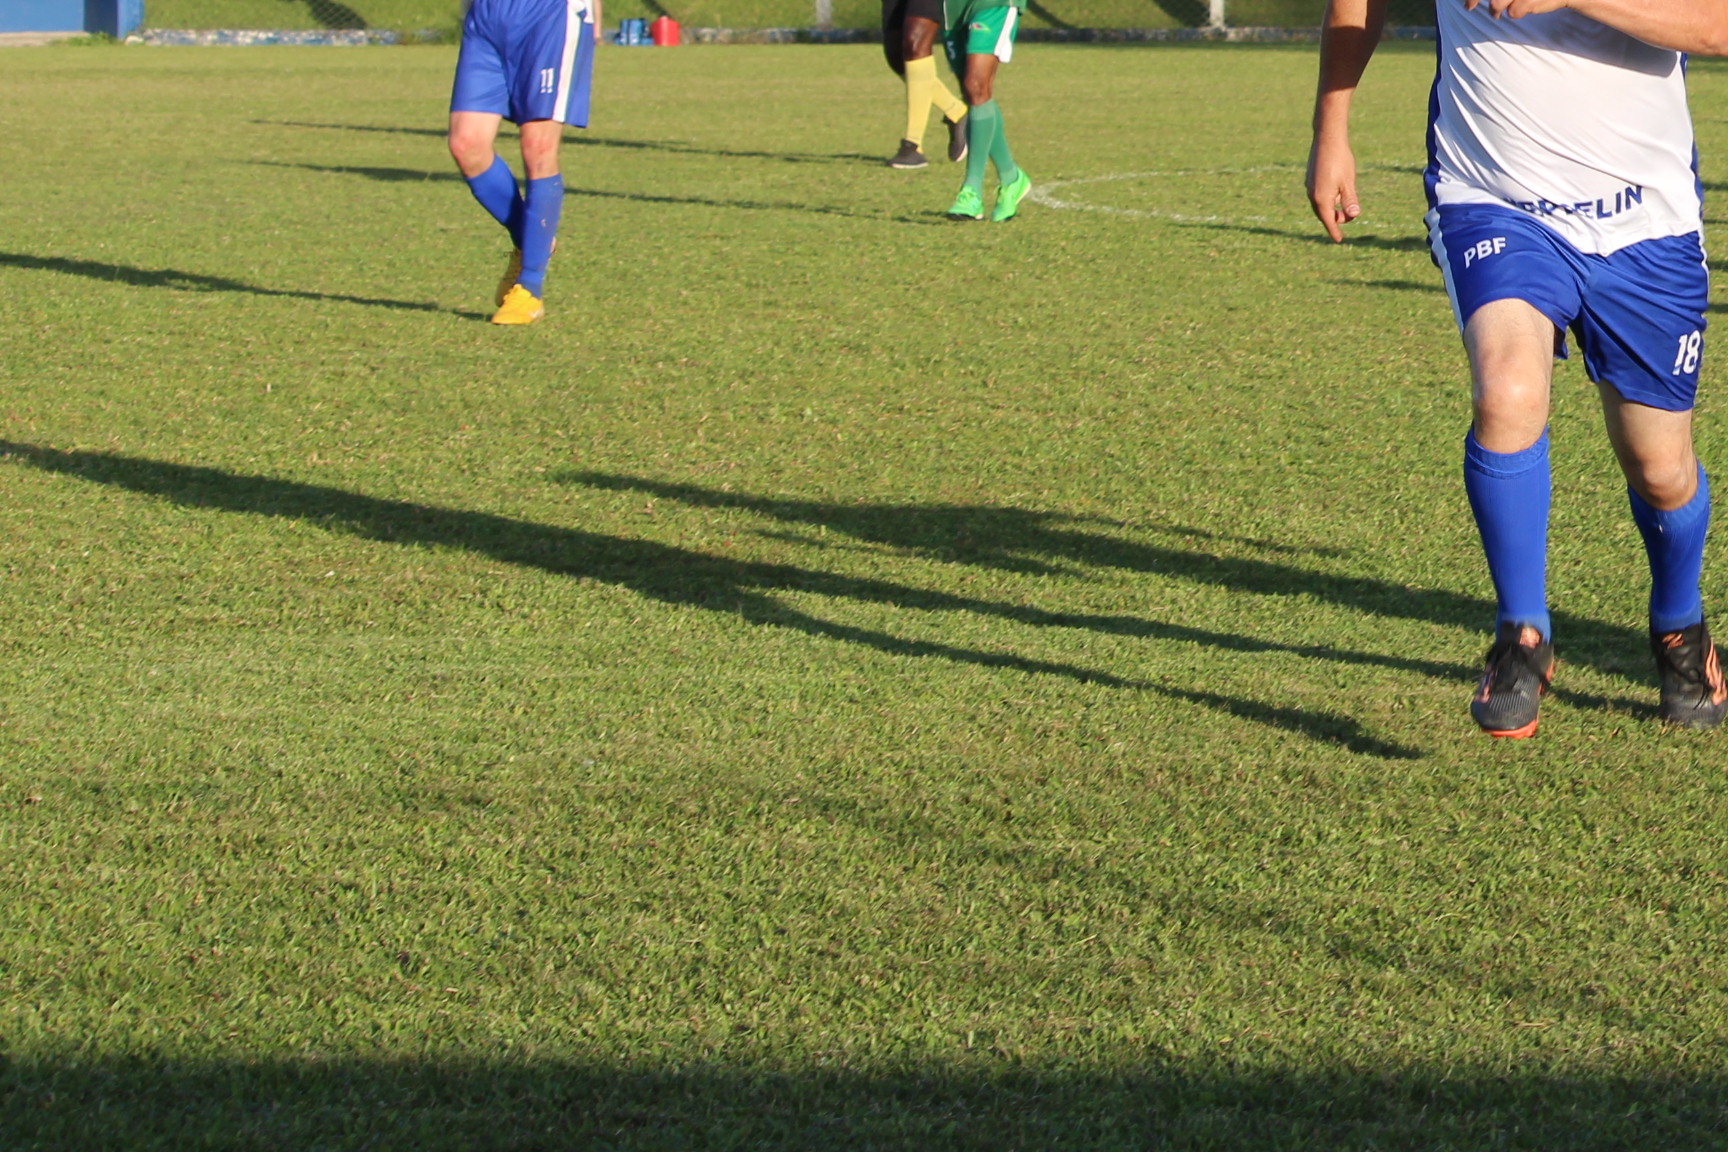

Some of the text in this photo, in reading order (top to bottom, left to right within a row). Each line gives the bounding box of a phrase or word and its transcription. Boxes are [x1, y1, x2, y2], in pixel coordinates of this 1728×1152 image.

[540, 68, 554, 94] 11
[1463, 237, 1506, 268] PBF
[1672, 330, 1701, 375] 18
